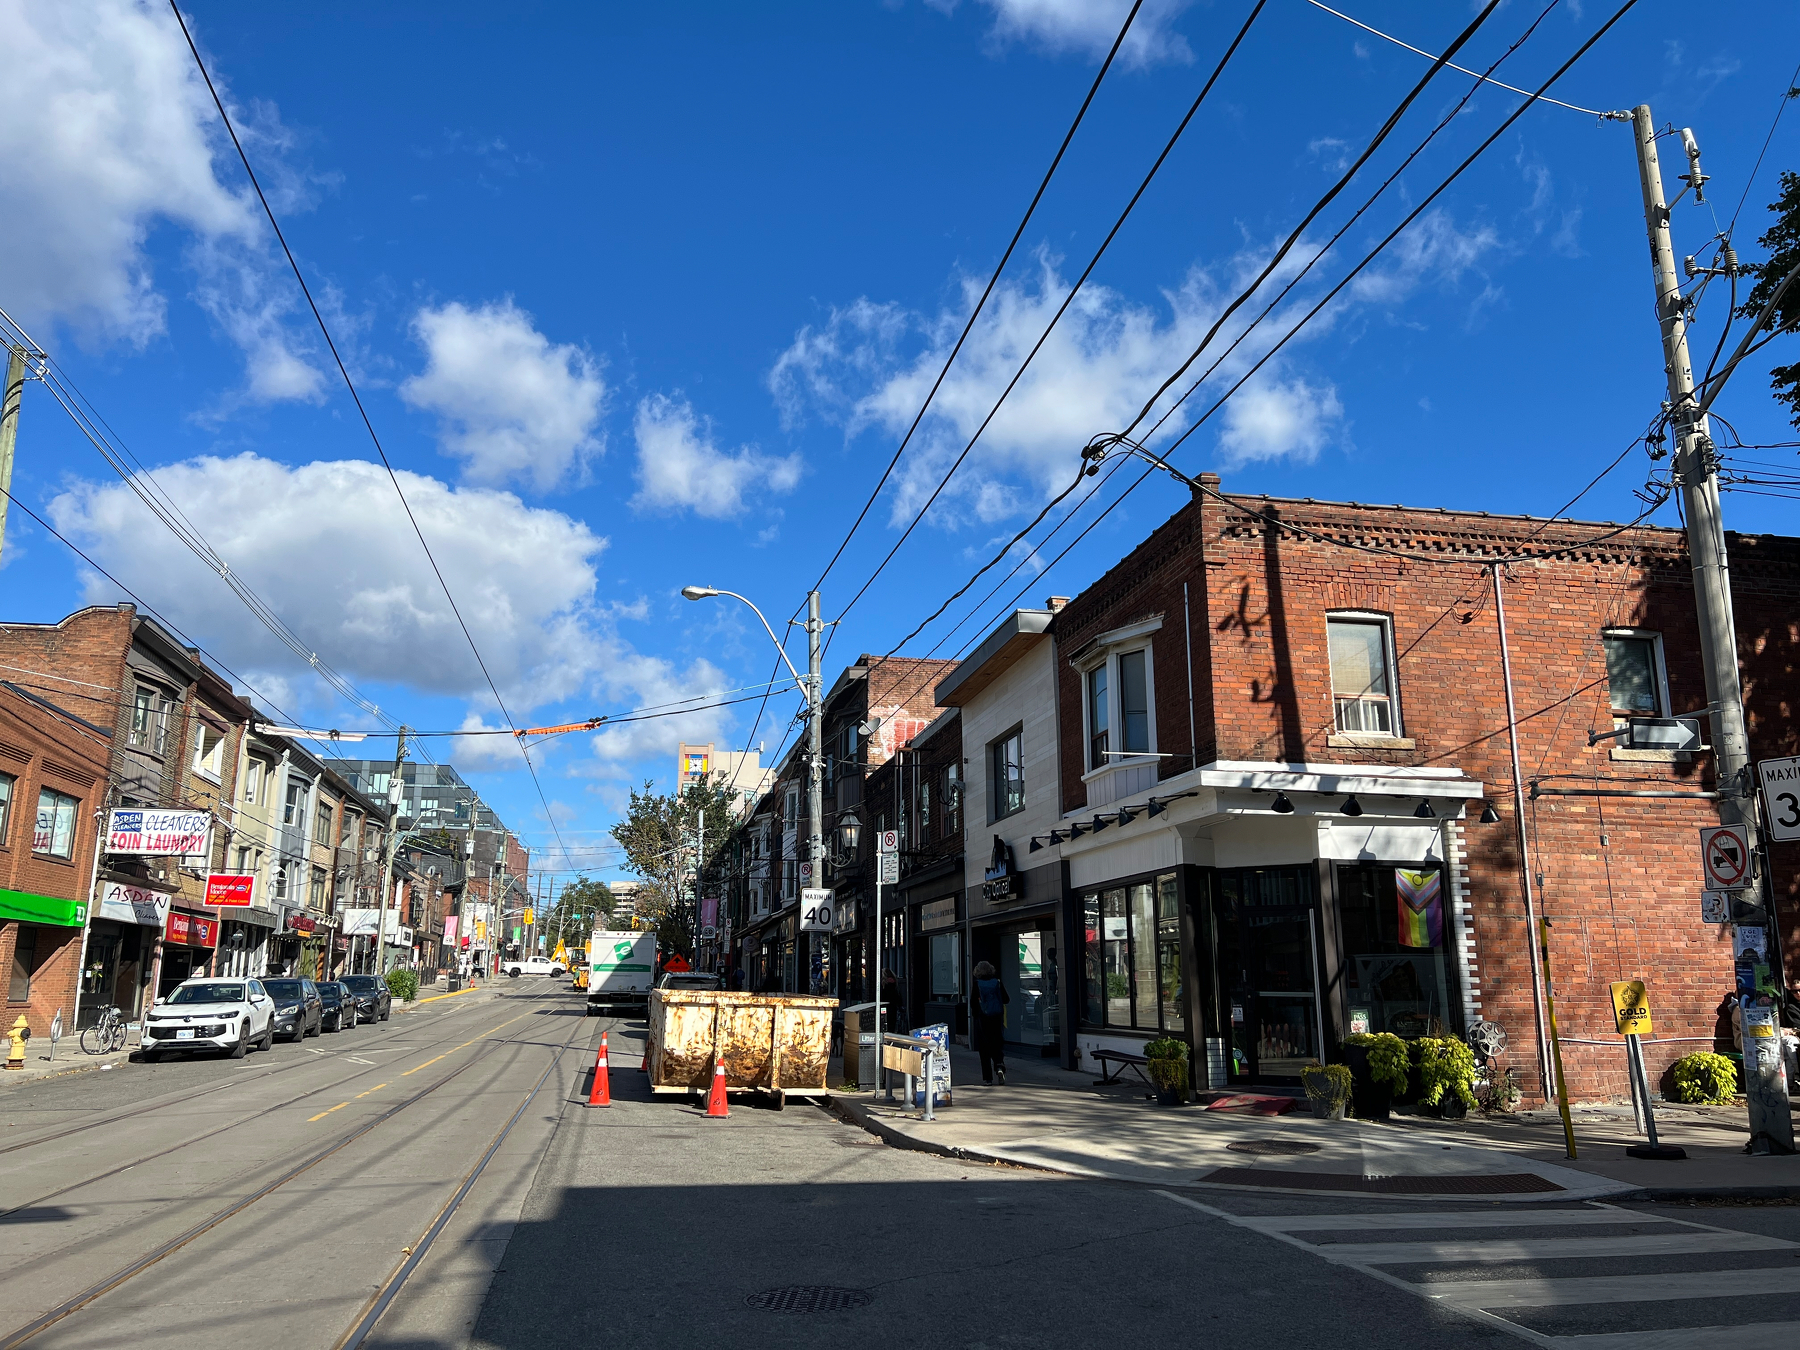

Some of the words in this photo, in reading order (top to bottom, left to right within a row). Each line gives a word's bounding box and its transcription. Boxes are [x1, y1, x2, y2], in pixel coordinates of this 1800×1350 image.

[1766, 767, 1800, 782] MAXI
[114, 814, 141, 824] ASPEN
[146, 814, 207, 832] CLEANERS
[110, 832, 140, 850] COIN
[146, 833, 205, 852] LAUNDRY
[210, 883, 235, 891] Benjamin
[107, 886, 168, 909] ASPEN
[805, 893, 832, 901] MAXIMUM
[135, 909, 162, 922] Cleaners
[804, 906, 831, 925] 40
[1619, 1007, 1646, 1016] GOLD
